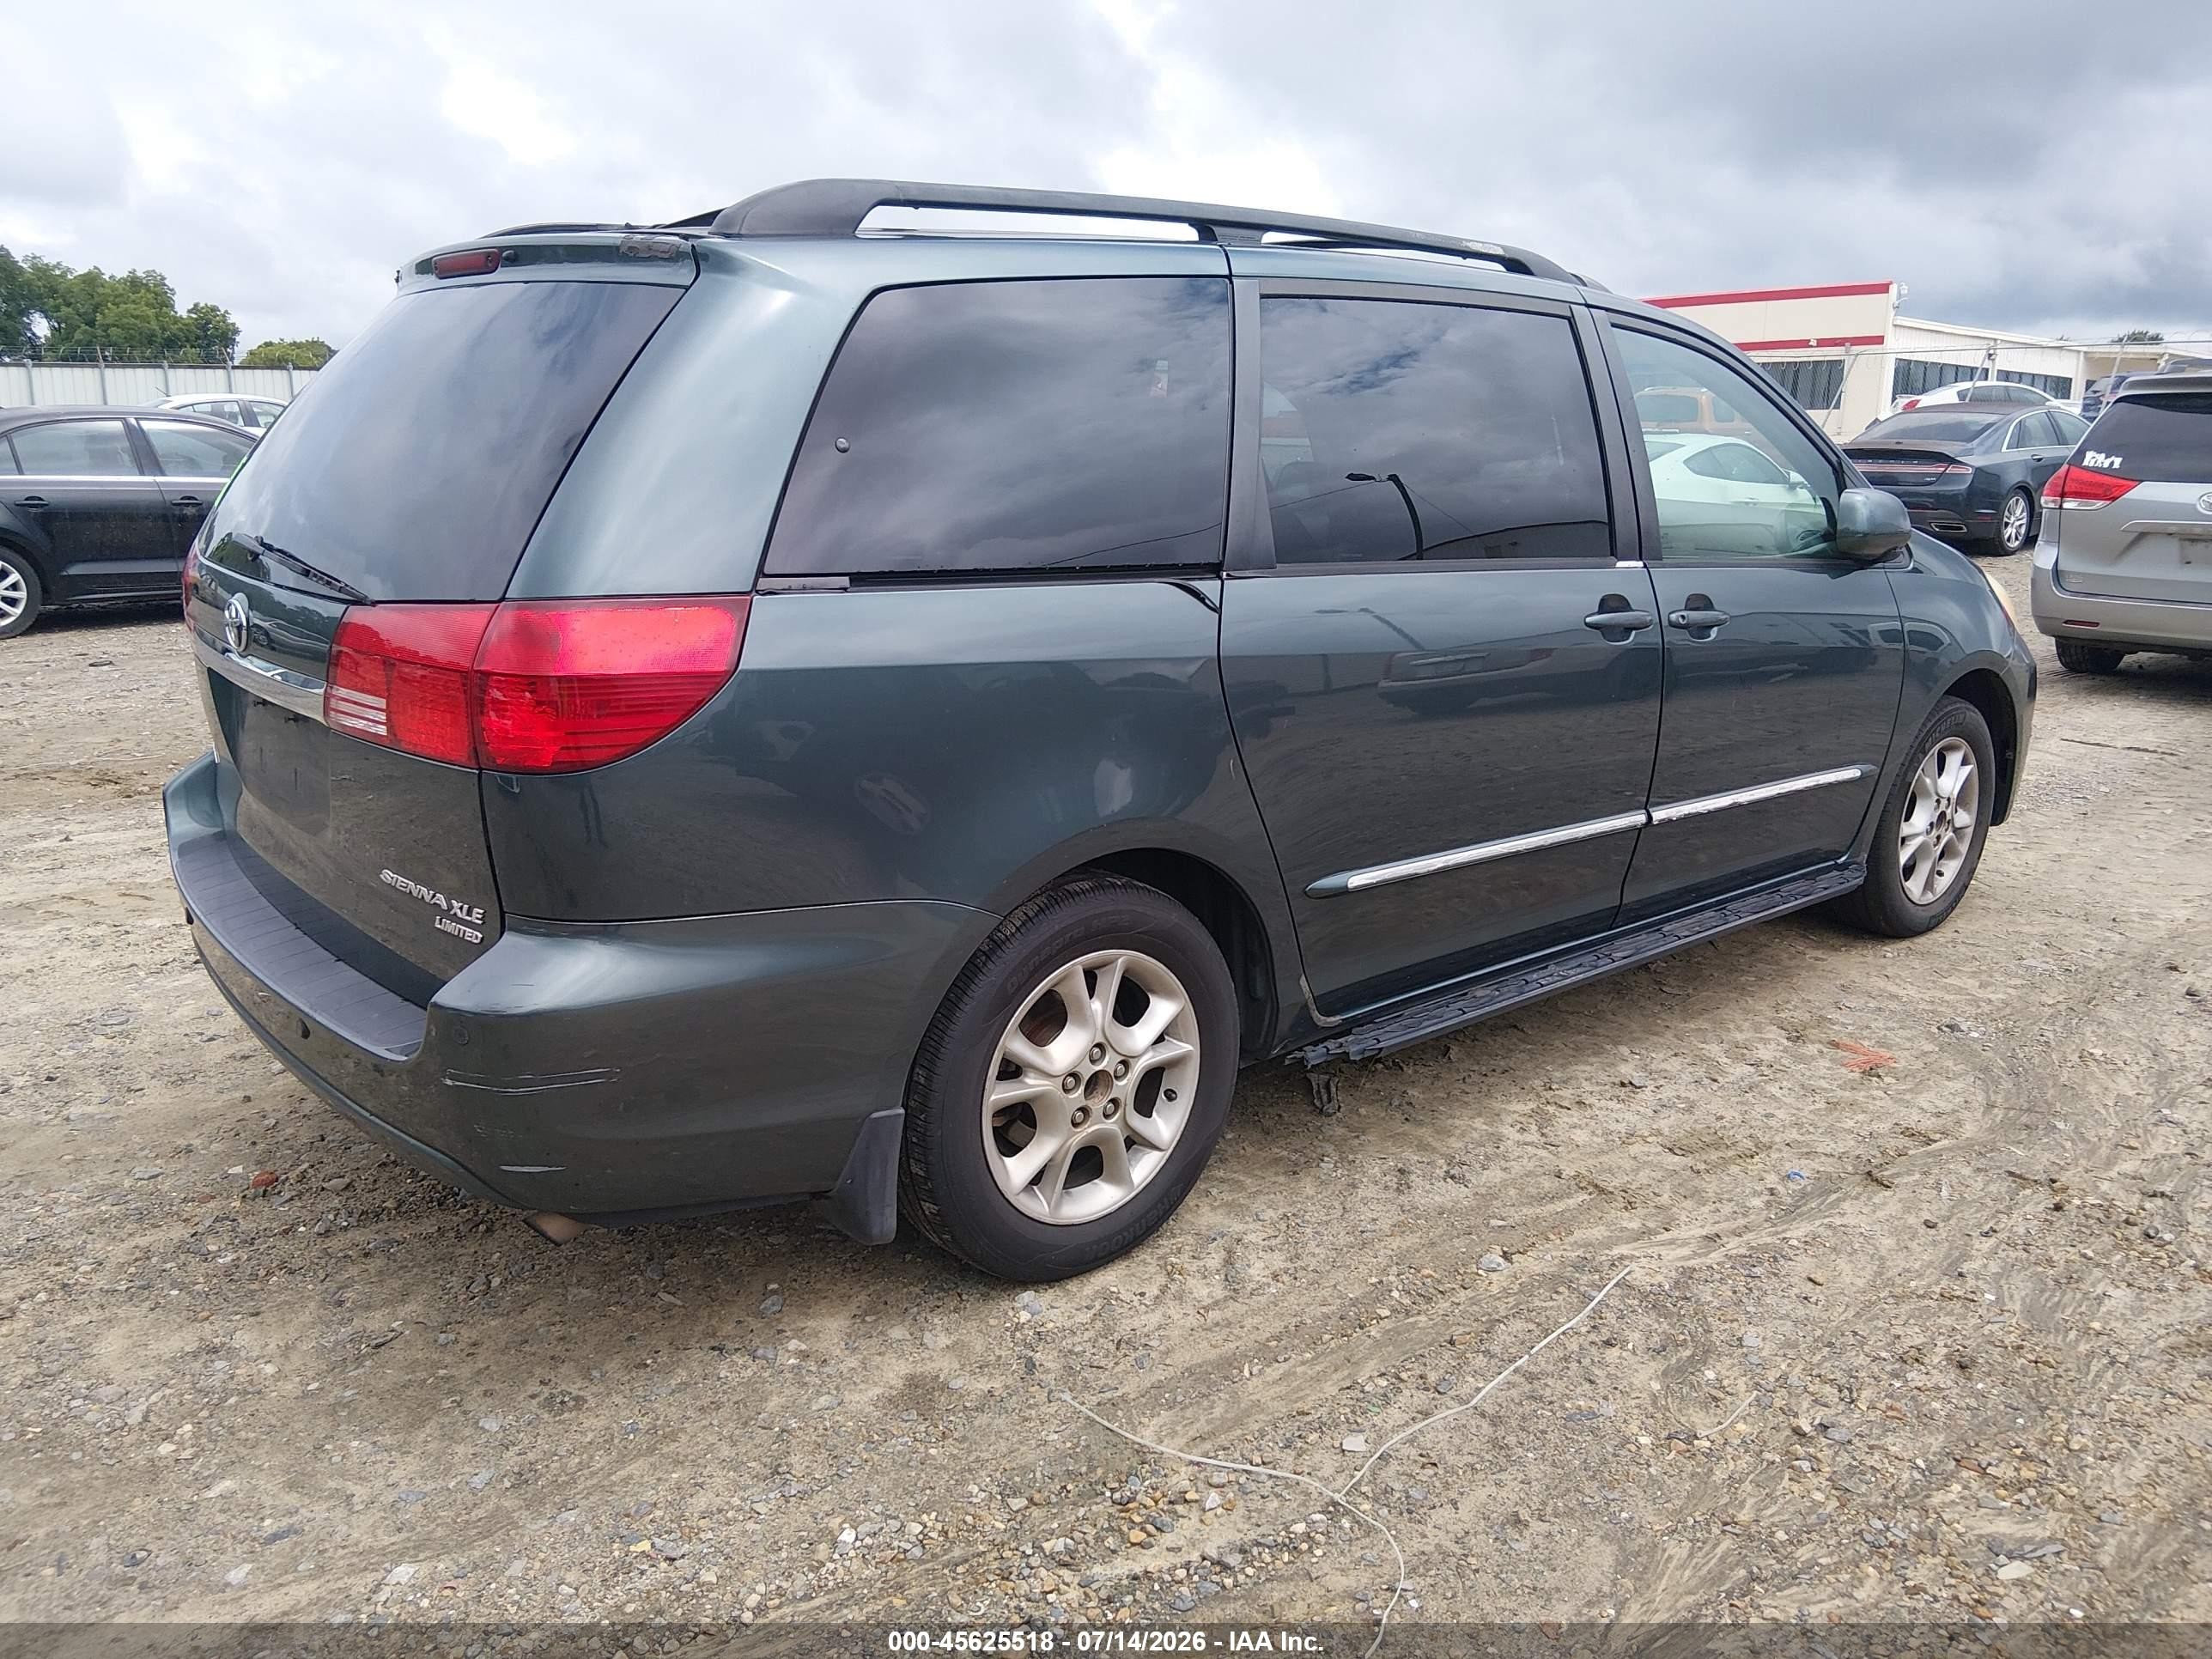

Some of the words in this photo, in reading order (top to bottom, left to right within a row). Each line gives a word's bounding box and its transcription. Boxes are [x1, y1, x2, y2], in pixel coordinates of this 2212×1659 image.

[378, 868, 448, 910] SIENNA
[449, 898, 486, 925] XLE
[434, 915, 483, 945] LIMITED
